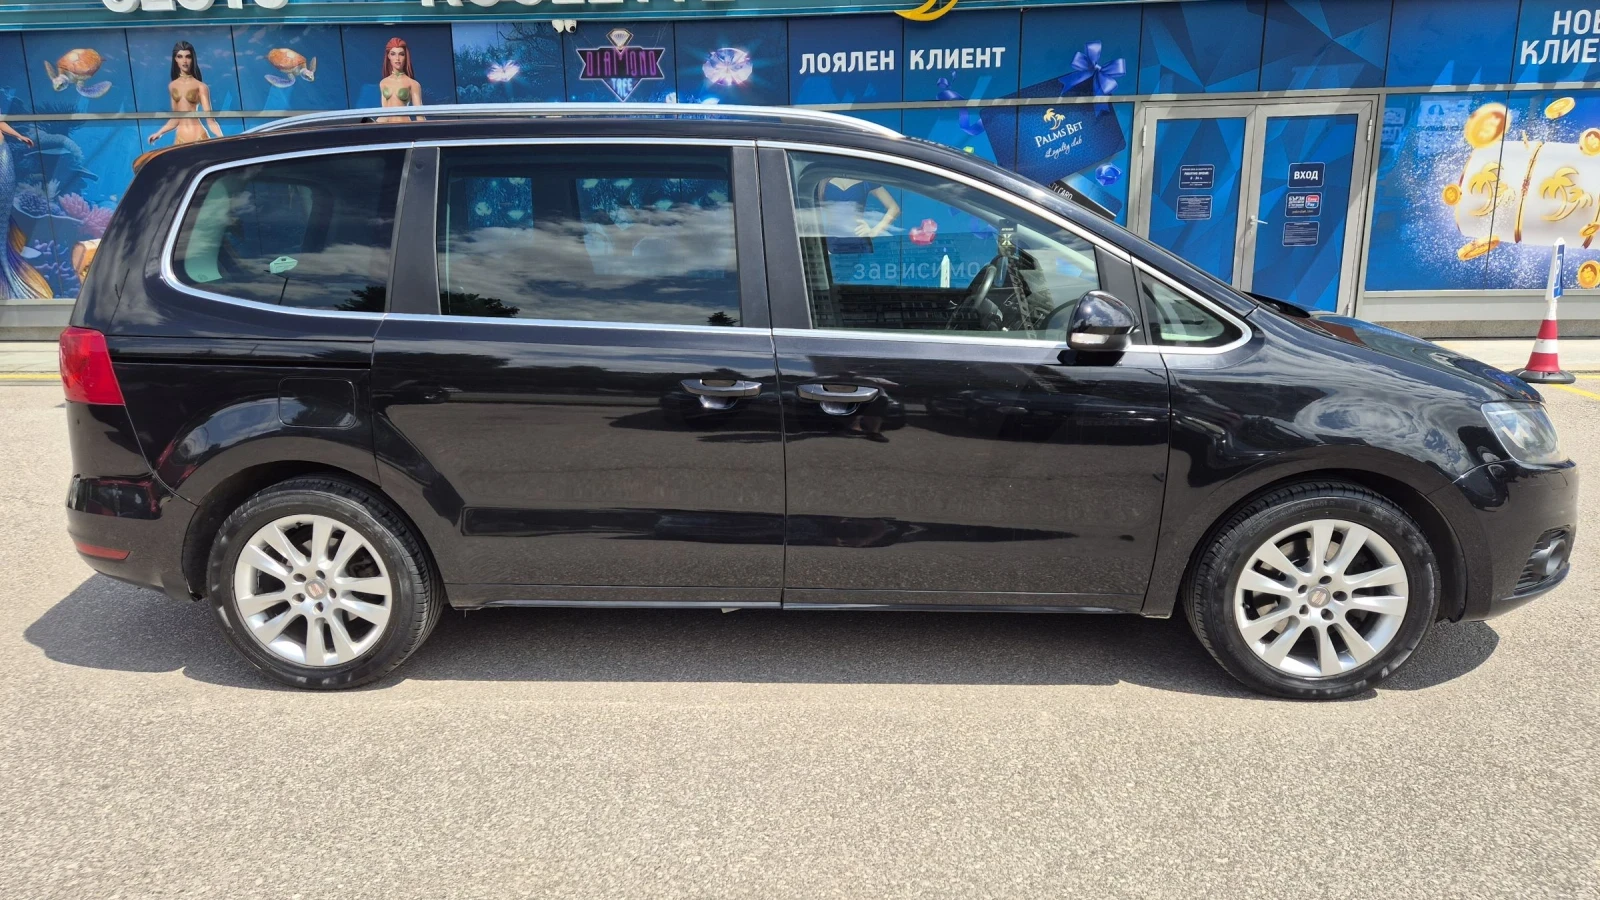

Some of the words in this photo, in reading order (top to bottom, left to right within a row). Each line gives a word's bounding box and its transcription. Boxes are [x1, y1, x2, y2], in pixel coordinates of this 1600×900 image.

[799, 50, 895, 75] ЛОЯЛЕН
[909, 47, 1006, 70] КЛИЕНТ
[1520, 38, 1600, 65] КЛИЕ
[586, 50, 657, 77] DIAMOND
[1293, 170, 1319, 180] ВХОД
[1057, 187, 1073, 200] CARD
[853, 262, 989, 280] зависимо
